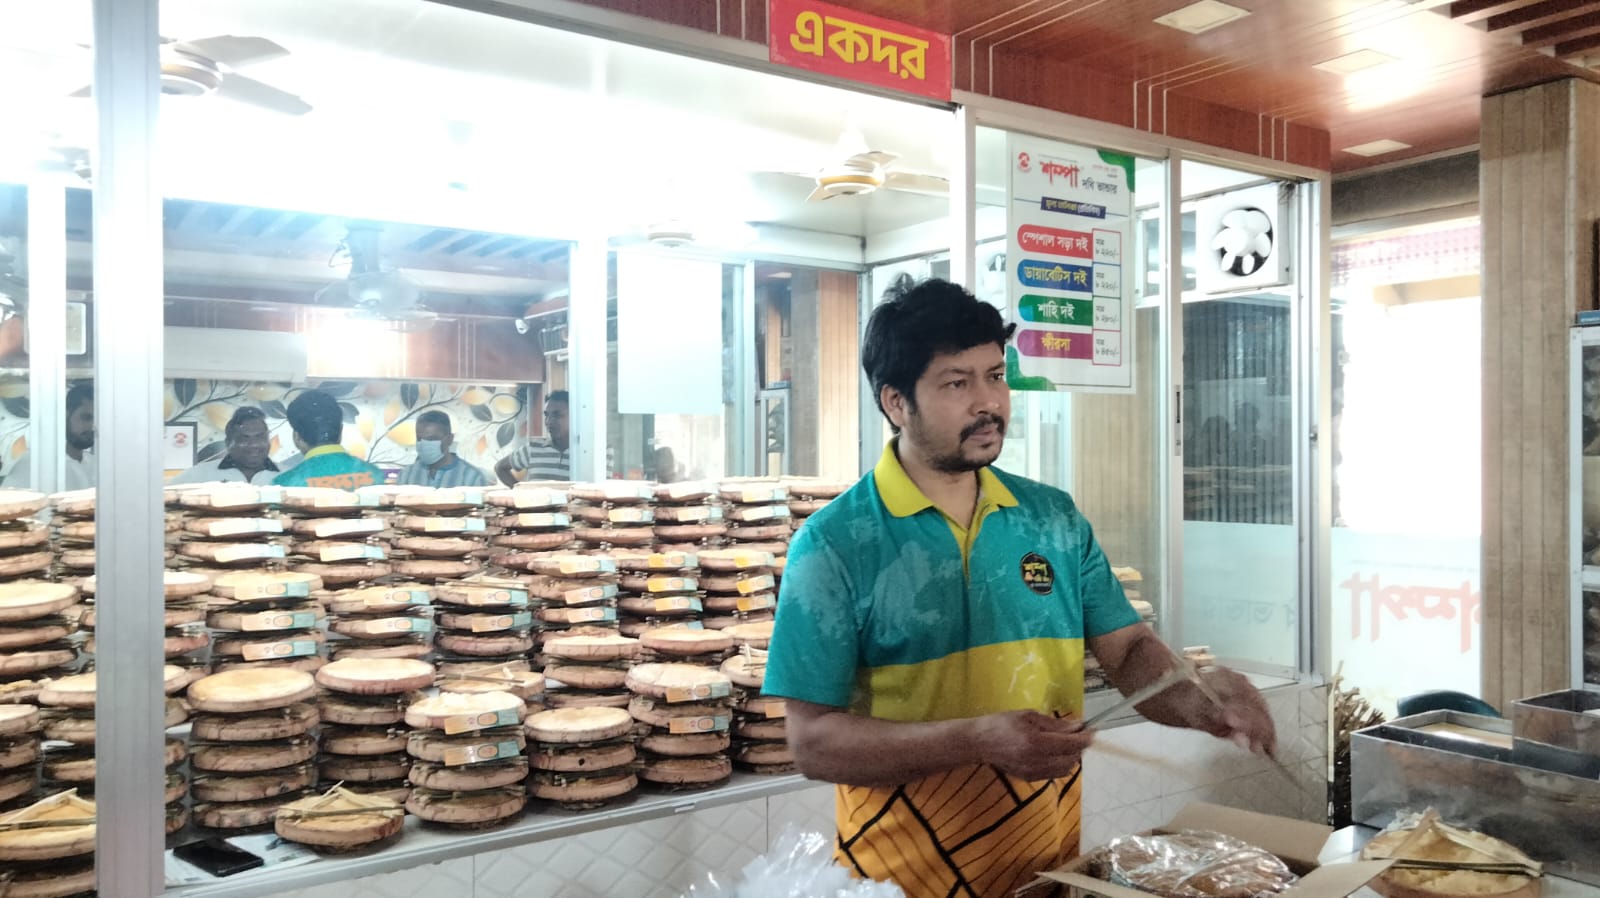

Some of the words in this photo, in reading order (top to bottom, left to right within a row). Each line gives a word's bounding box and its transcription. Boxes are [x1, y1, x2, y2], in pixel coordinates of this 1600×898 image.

[789, 11, 930, 80] একদর
[1022, 231, 1056, 247] স্পেশাল
[1076, 237, 1088, 252] দই
[1073, 269, 1088, 287] দই
[1037, 301, 1059, 320] শাহি
[1060, 302, 1075, 320] দই
